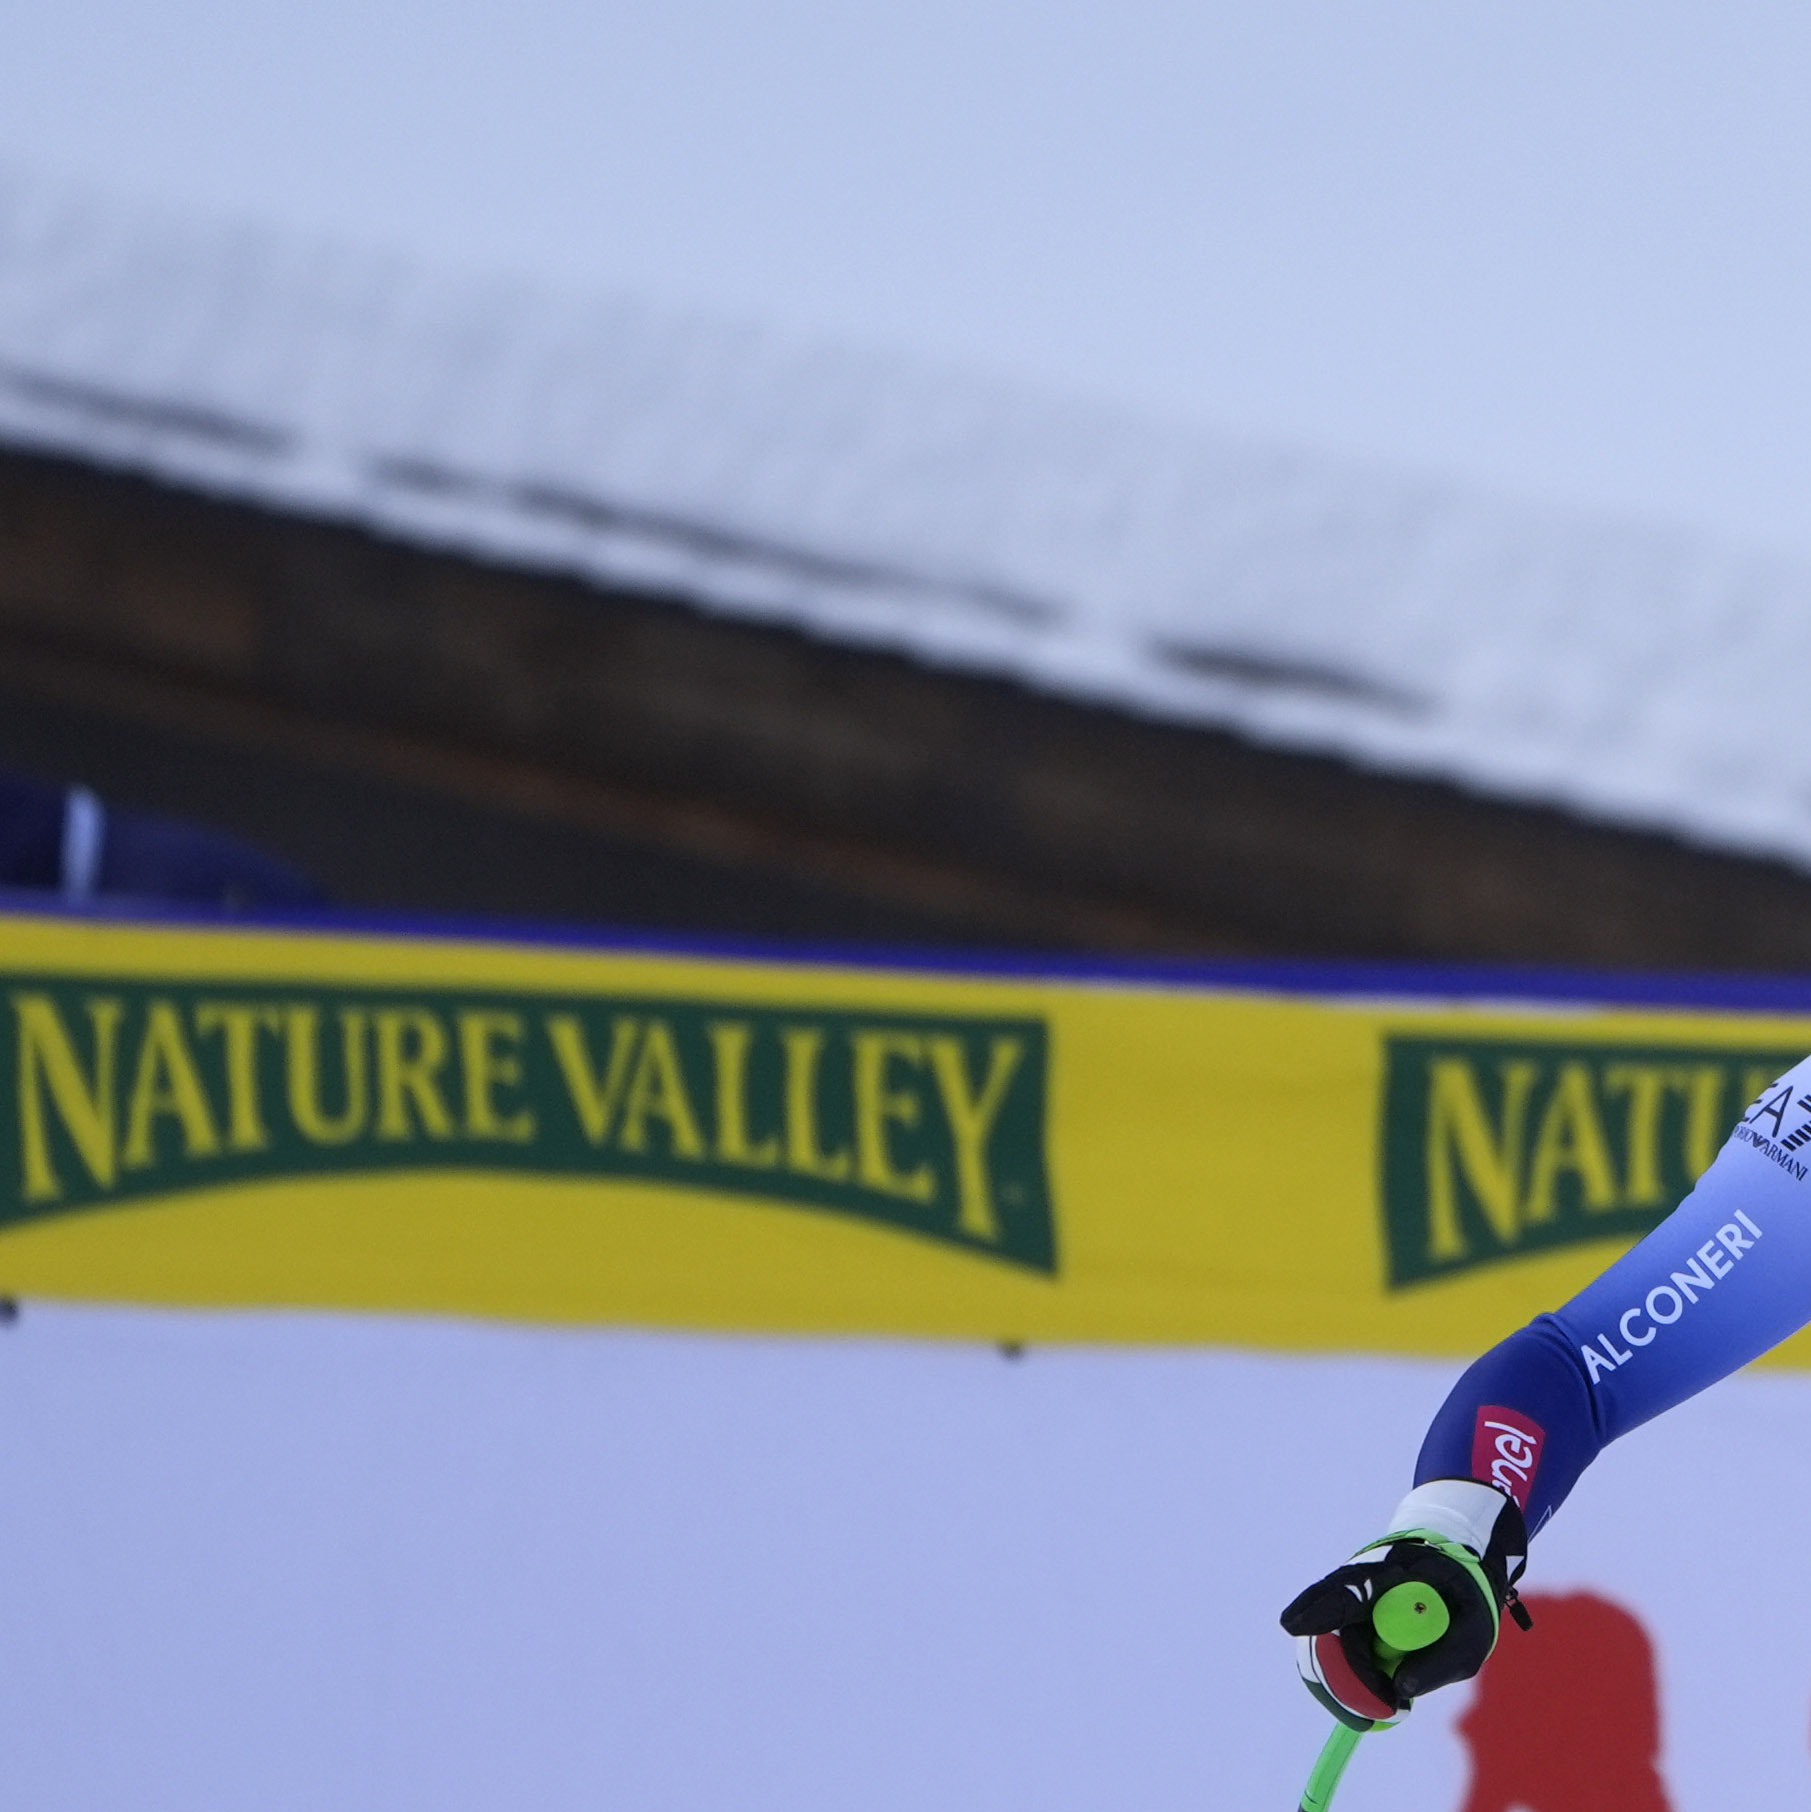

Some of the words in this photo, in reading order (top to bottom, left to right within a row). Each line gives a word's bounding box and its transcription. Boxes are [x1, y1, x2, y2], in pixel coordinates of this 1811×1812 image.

[17, 992, 534, 1200] NATURE
[545, 1012, 1023, 1242] VALLEY
[1428, 1059, 1772, 1260] NATU
[1581, 1209, 1763, 1385] ALCONERI
